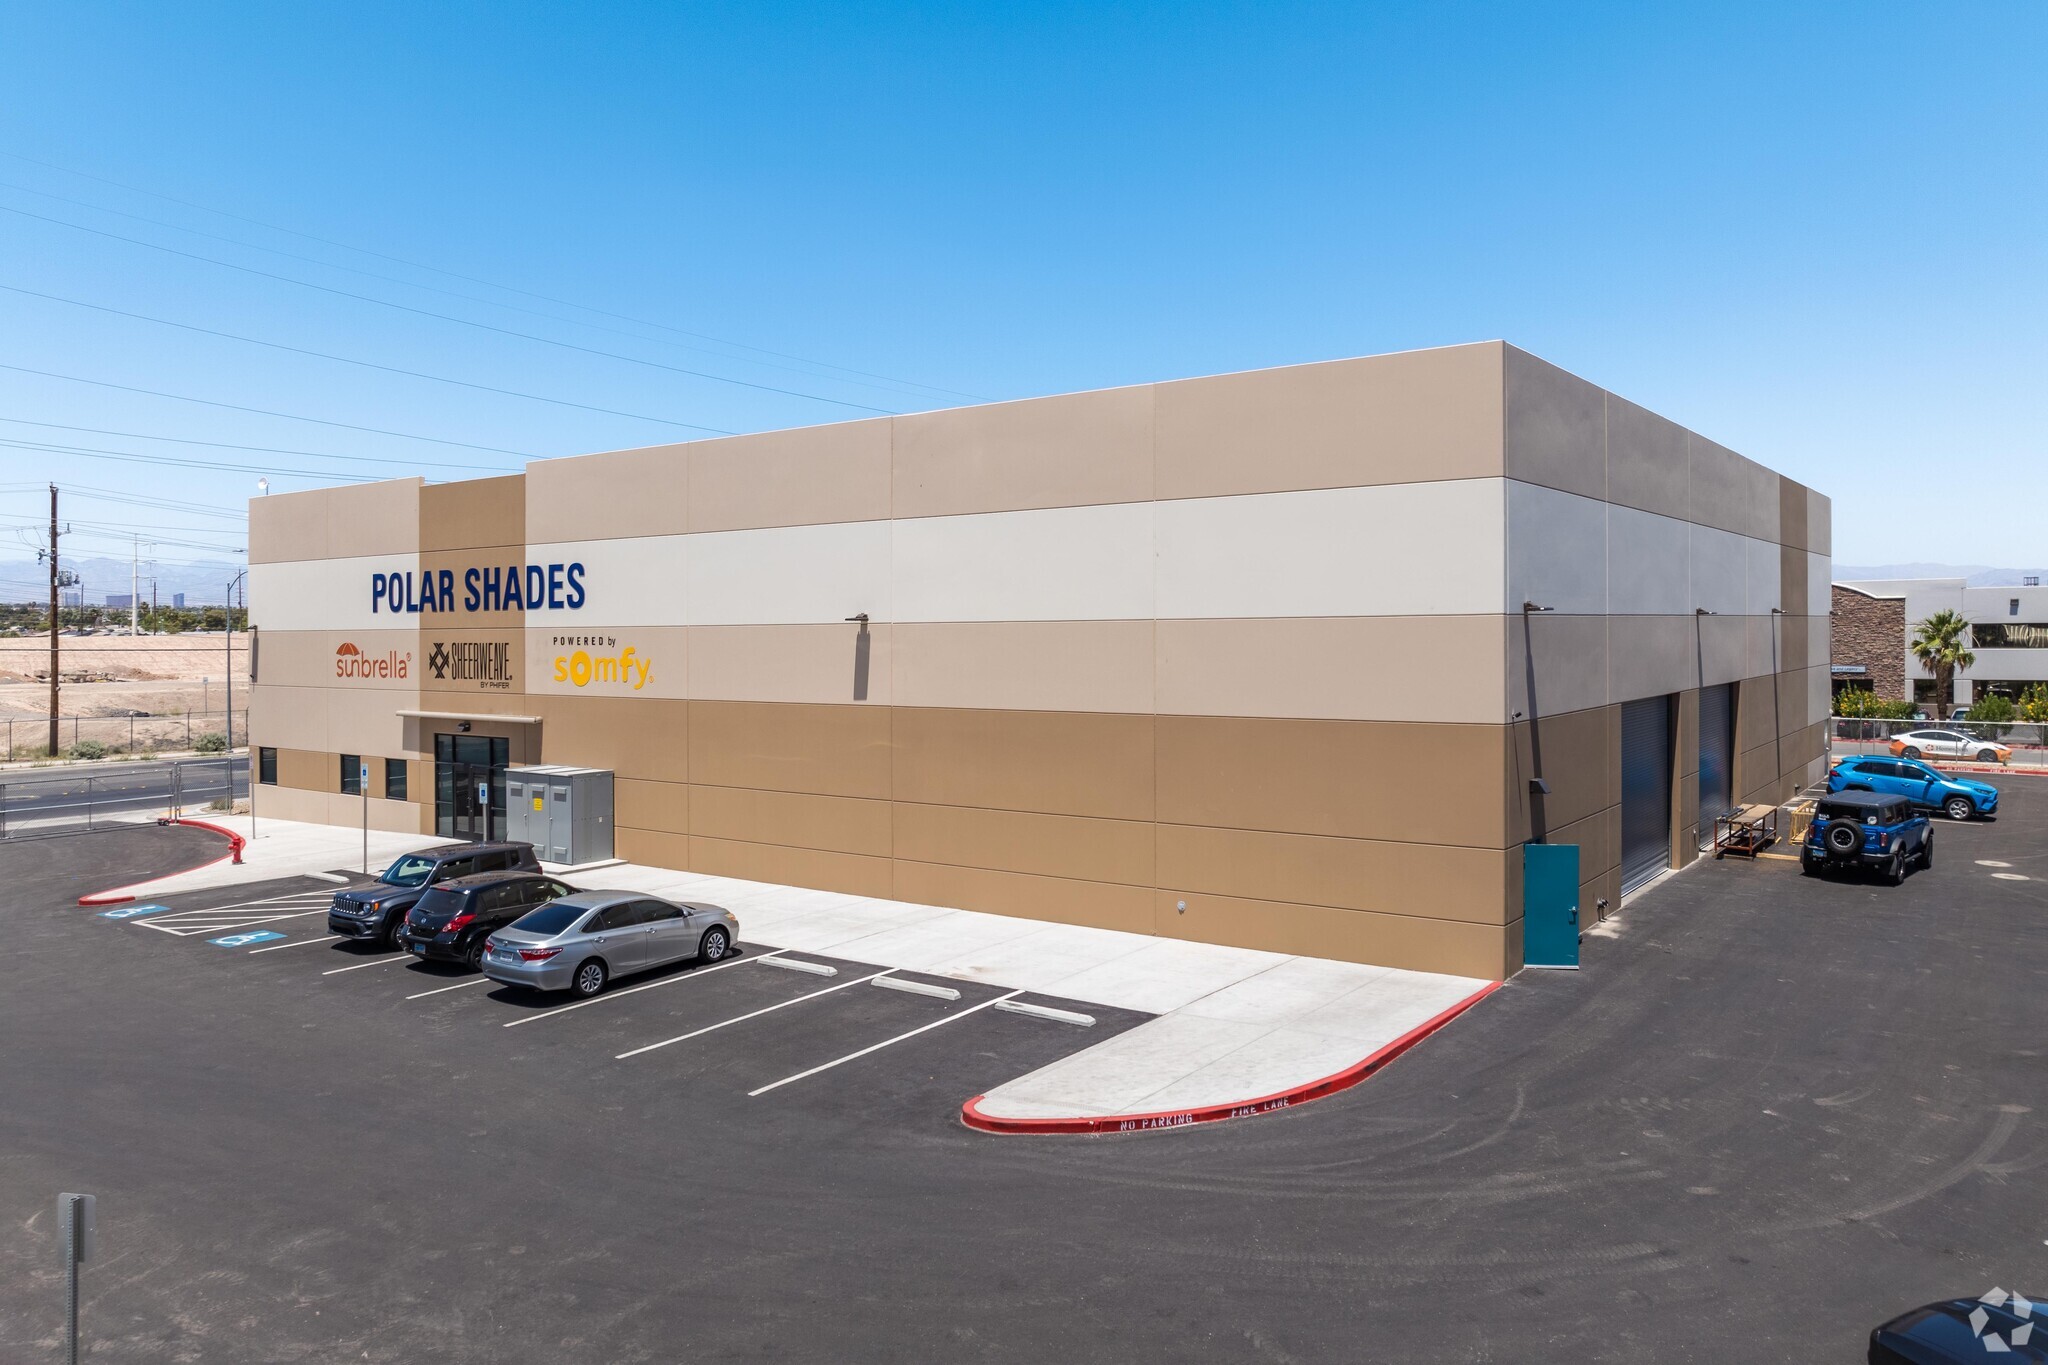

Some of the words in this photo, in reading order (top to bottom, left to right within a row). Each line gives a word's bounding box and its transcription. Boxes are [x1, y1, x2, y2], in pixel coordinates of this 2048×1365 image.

[372, 569, 455, 613] POLAR
[464, 562, 586, 612] SHADES
[553, 636, 604, 646] POWERED
[607, 636, 616, 647] by
[480, 681, 489, 689] BY
[489, 681, 510, 689] PHIFER
[1935, 745, 1968, 753] Homescom
[1231, 1103, 1257, 1119] FIRE
[1263, 1096, 1290, 1111] LANE
[1120, 1120, 1136, 1131] NO
[1142, 1113, 1193, 1129] PARKING
